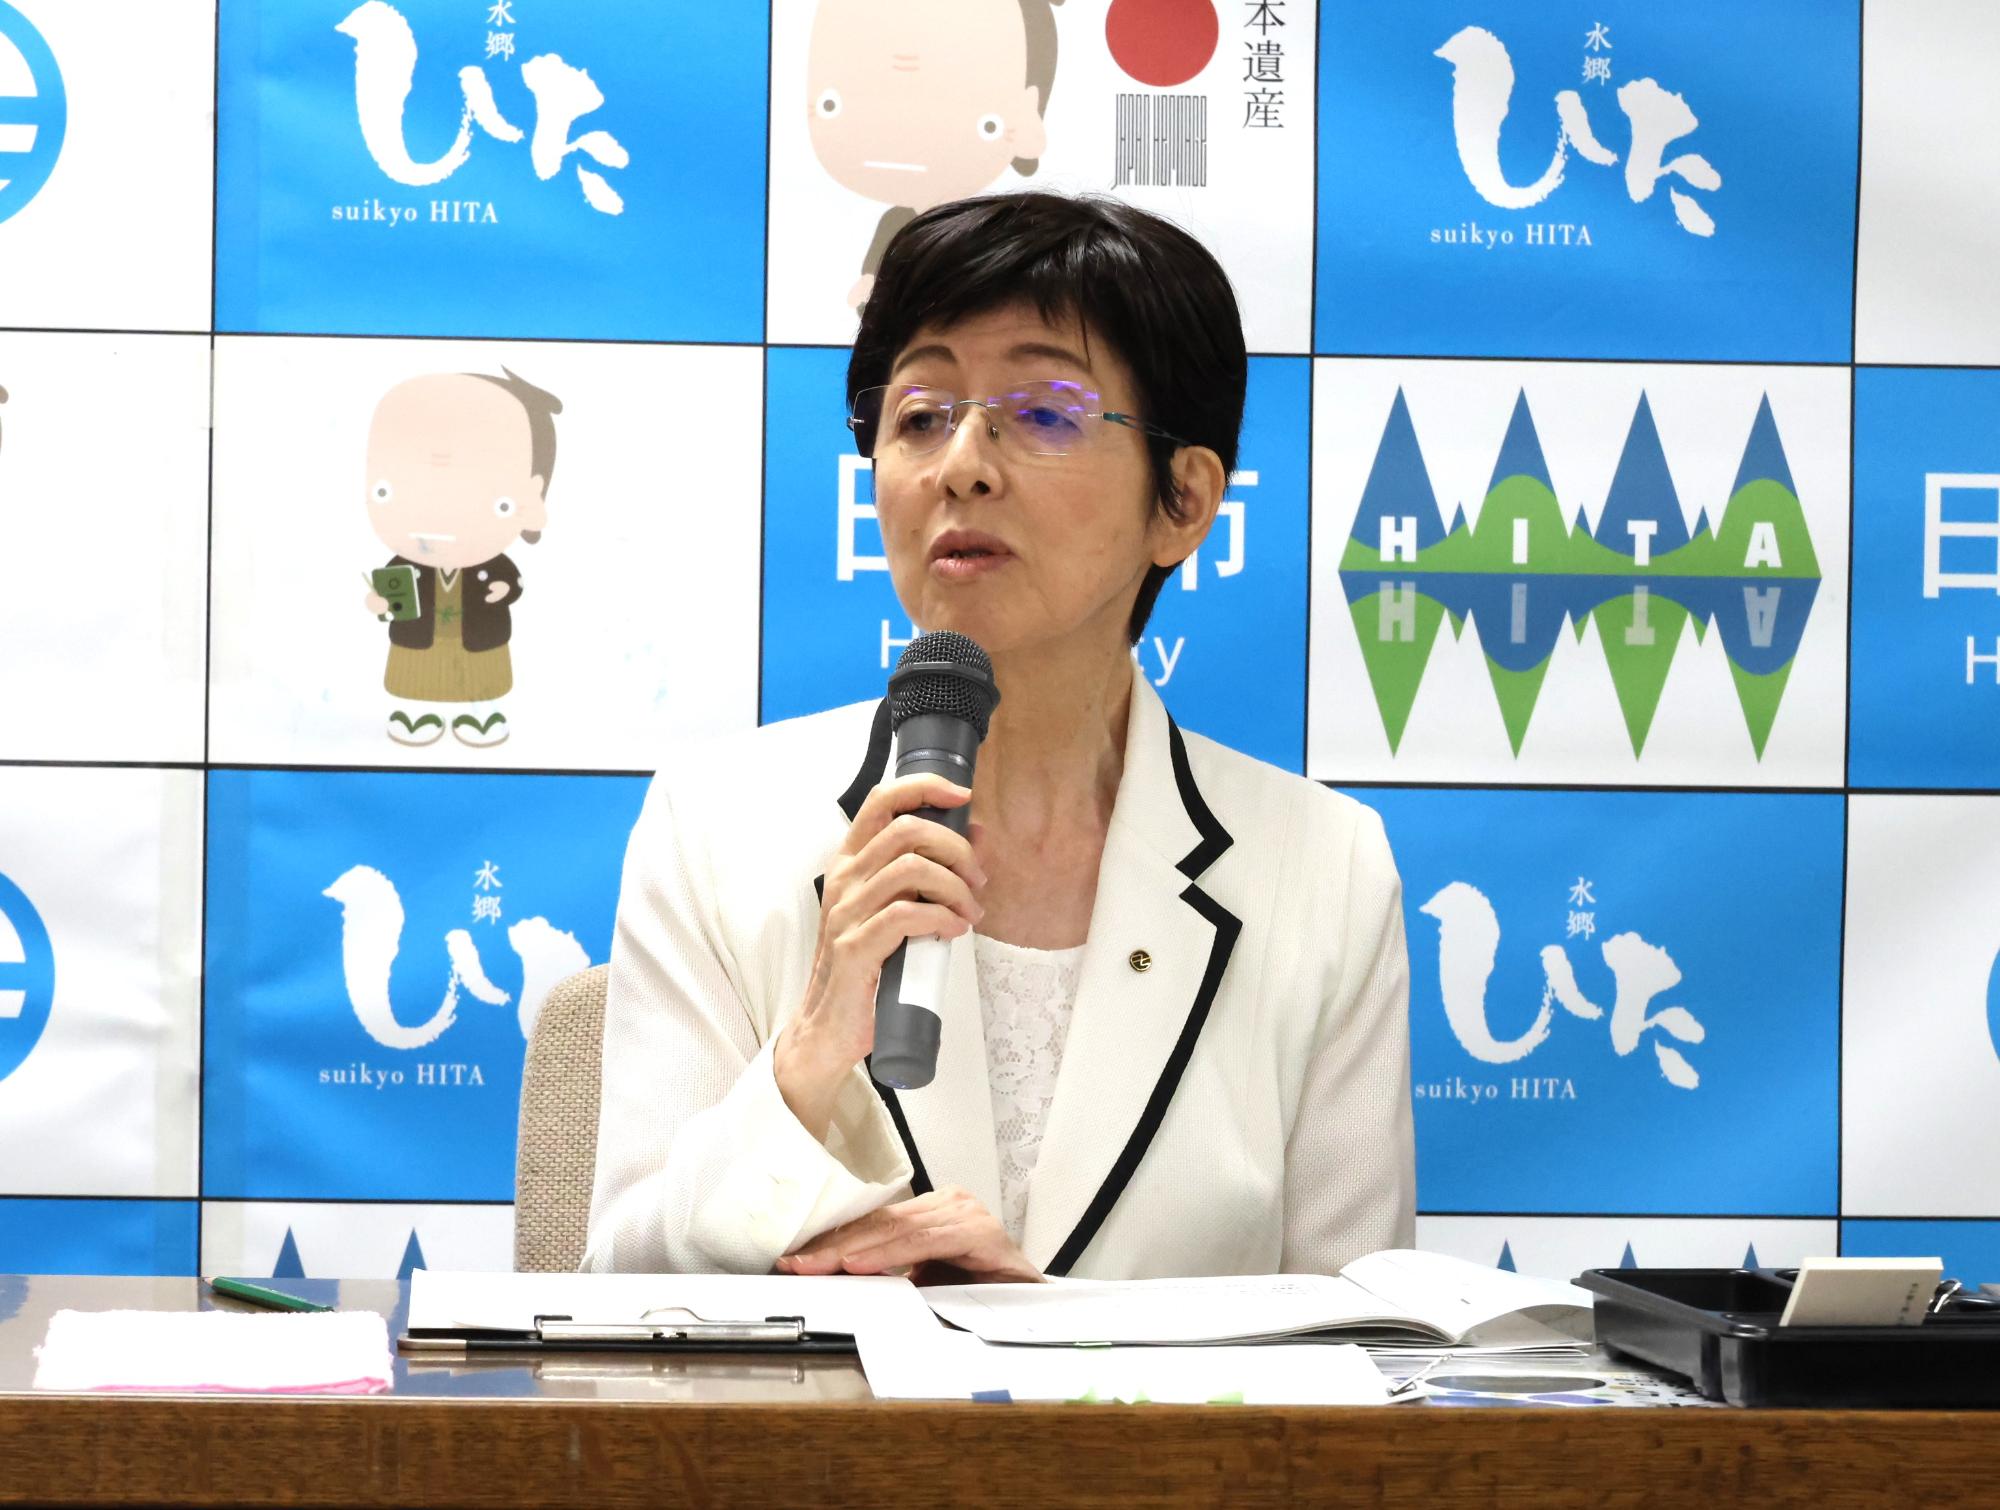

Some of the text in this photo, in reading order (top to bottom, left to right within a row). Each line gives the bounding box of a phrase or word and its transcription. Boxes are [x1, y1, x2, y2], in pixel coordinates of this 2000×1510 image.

[485, 0, 516, 61] 水郷
[1582, 22, 1613, 86] 水郷
[1242, 0, 1287, 129] 本遺産
[1431, 25, 1722, 237] ひた
[332, 199, 499, 227] suikyo HITA
[1430, 222, 1592, 250] suikyo HITA
[1379, 515, 1783, 568] HITA
[472, 860, 503, 925] 水郷
[1566, 876, 1597, 941] 水郷
[1419, 880, 1706, 1090] ひた
[319, 1062, 485, 1090] suikyo HITA
[1414, 1076, 1577, 1104] suikyo HITA
